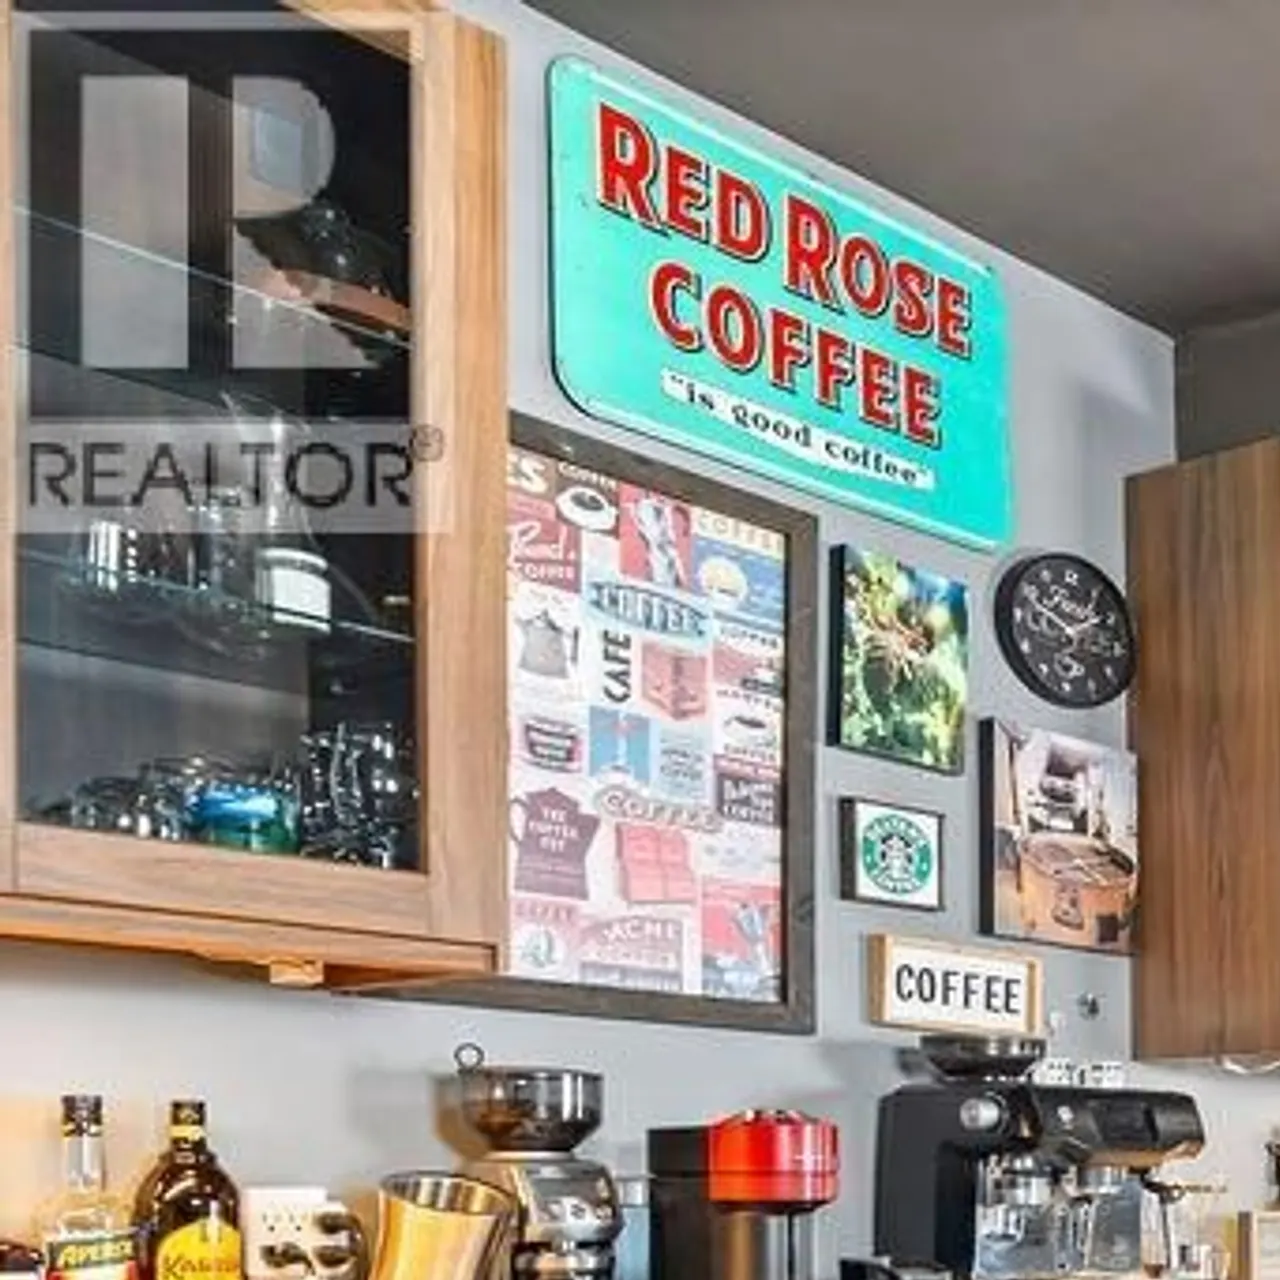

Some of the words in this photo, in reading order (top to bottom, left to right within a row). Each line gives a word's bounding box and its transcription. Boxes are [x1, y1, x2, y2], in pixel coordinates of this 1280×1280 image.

[597, 101, 771, 263] RED
[784, 194, 972, 360] ROSE
[649, 261, 942, 450] COFFEE
[731, 404, 813, 449] good
[603, 630, 631, 702] CAFE
[896, 964, 1021, 1014] COFFEE
